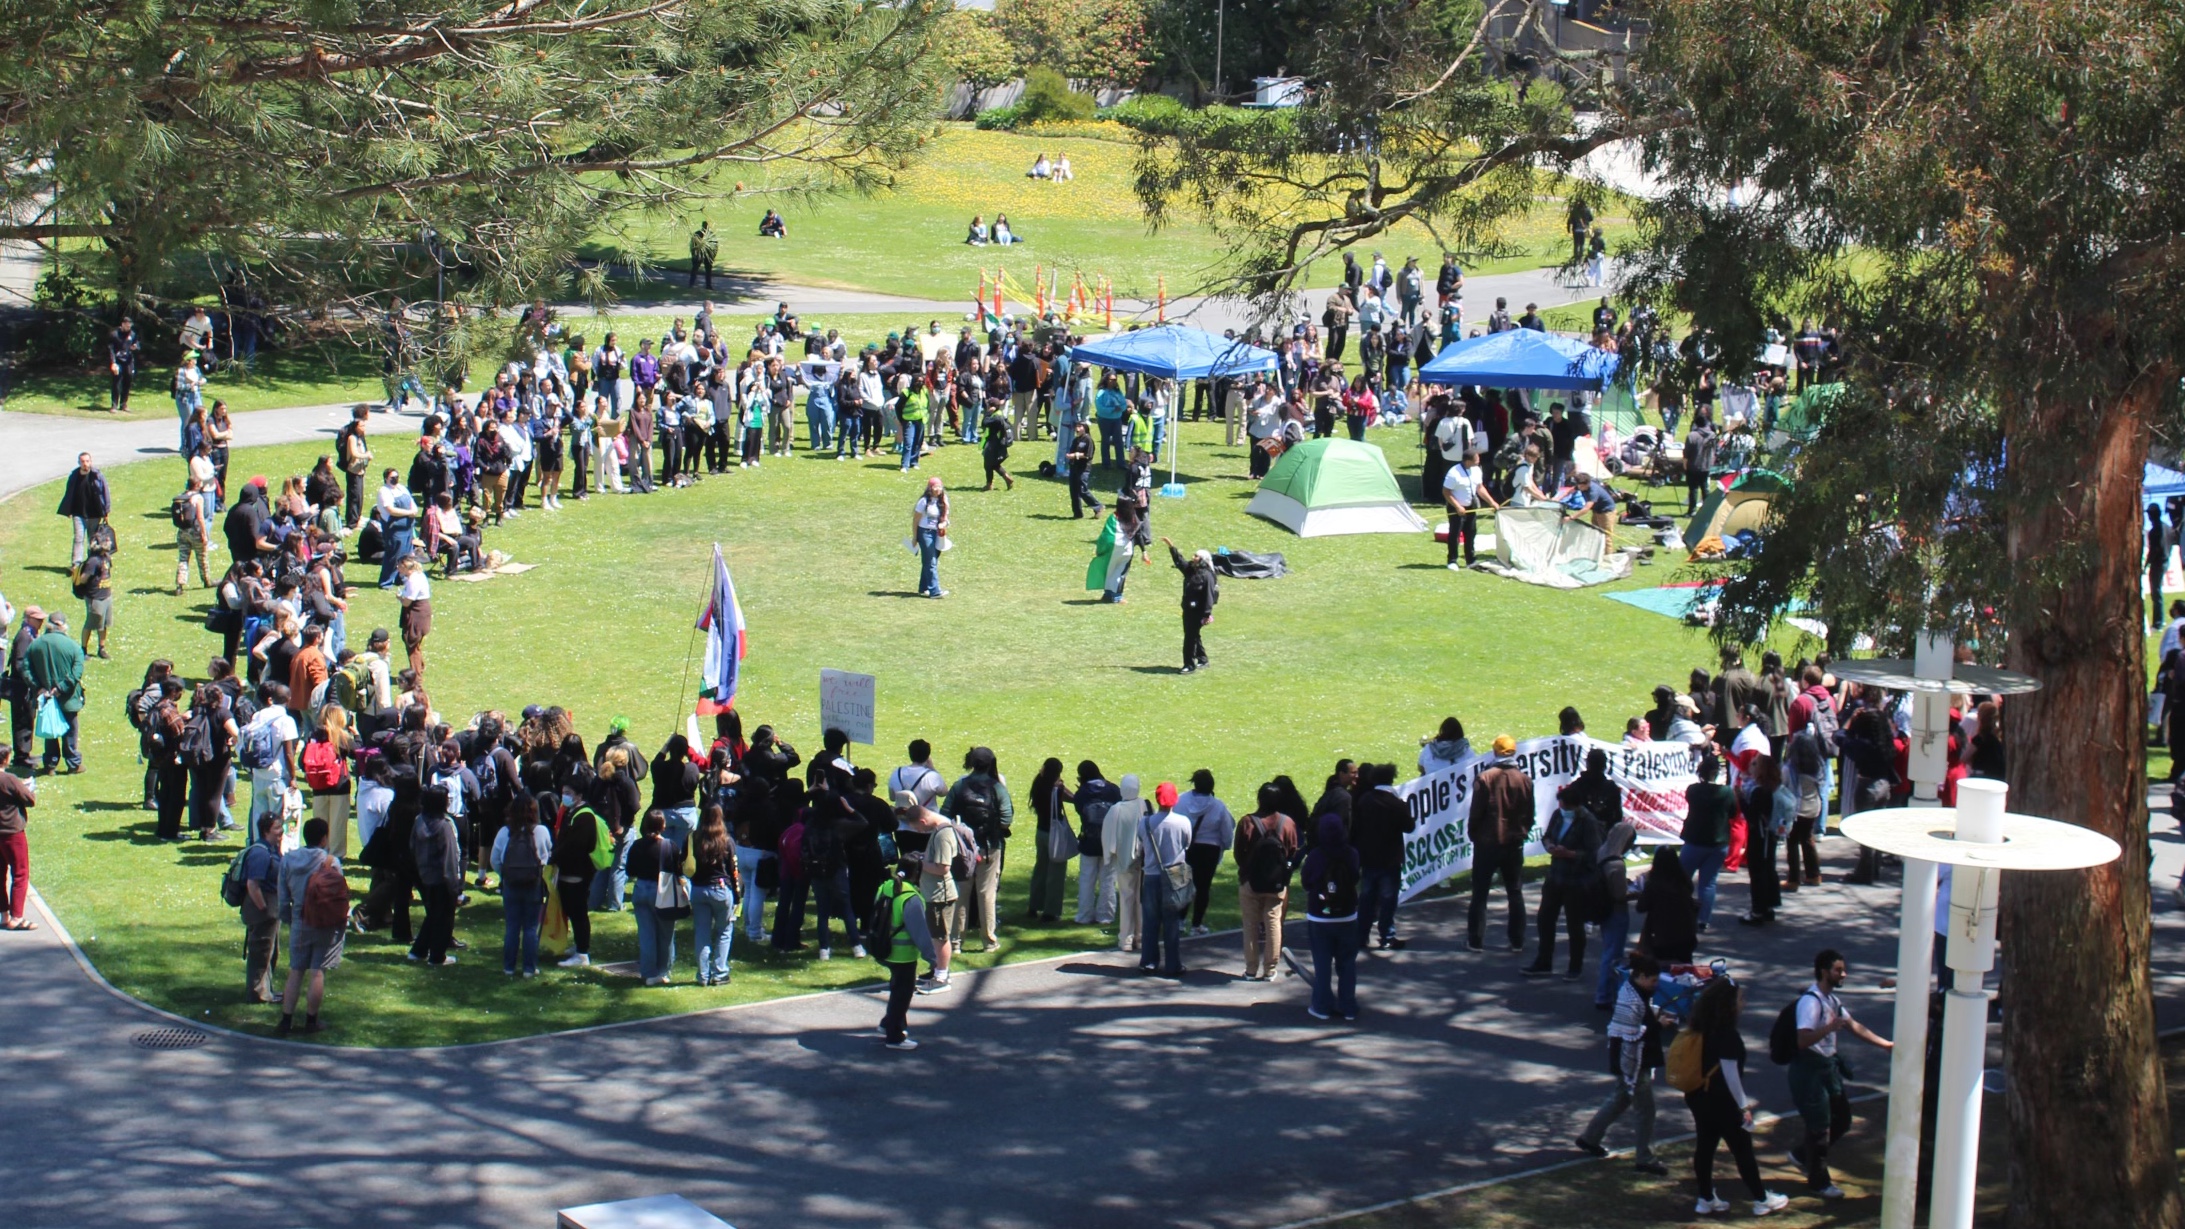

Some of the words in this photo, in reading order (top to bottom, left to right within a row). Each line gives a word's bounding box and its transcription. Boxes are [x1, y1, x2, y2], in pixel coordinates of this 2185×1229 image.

[821, 698, 874, 719] PALESTINE
[1407, 772, 1467, 826] ople's
[1473, 739, 1583, 780] ersity
